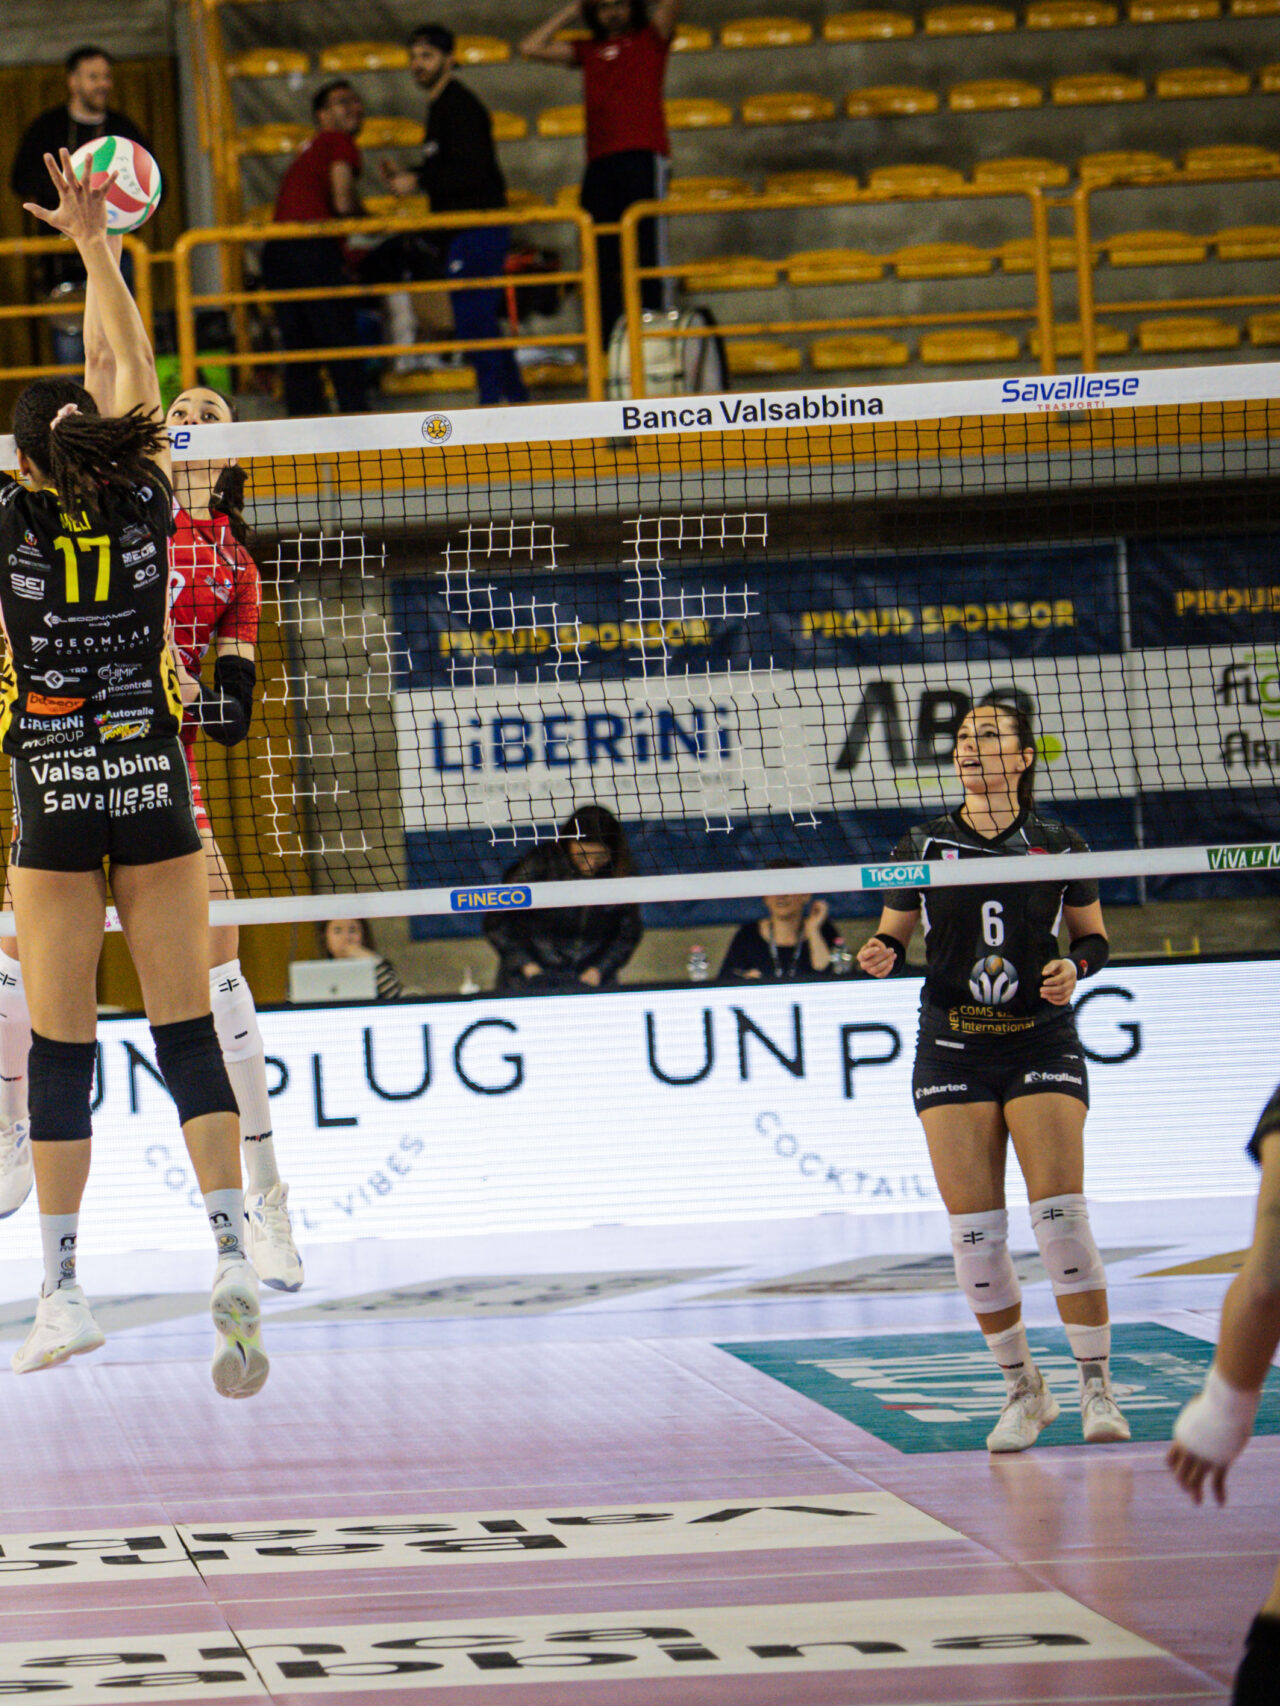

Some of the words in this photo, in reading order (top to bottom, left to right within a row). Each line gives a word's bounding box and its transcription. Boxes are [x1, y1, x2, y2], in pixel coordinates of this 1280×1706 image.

[1002, 376, 1138, 402] Savallese
[622, 406, 713, 431] Banca
[719, 394, 884, 426] Valsabbina
[1038, 400, 1106, 411] TRASPORTI
[10, 573, 45, 592] SEI
[53, 534, 111, 604] 17
[801, 609, 914, 639] PROUD
[921, 601, 1075, 634] SPONSOR
[439, 628, 551, 658] PROUD
[559, 620, 713, 652] SPONSOR
[106, 707, 154, 718] Autovalle
[30, 754, 170, 785] Valsabbina
[43, 782, 169, 814] Savallese
[109, 798, 172, 818] TRASPORTI
[1252, 850, 1264, 865] LA
[457, 888, 526, 908] FINECO
[981, 900, 1005, 946] 6
[960, 1005, 994, 1018] COMS
[961, 1019, 1036, 1034] International
[644, 985, 1143, 1100] UNPG
[755, 1110, 937, 1200] COCKTAIL
[333, 1134, 426, 1217] VIBES
